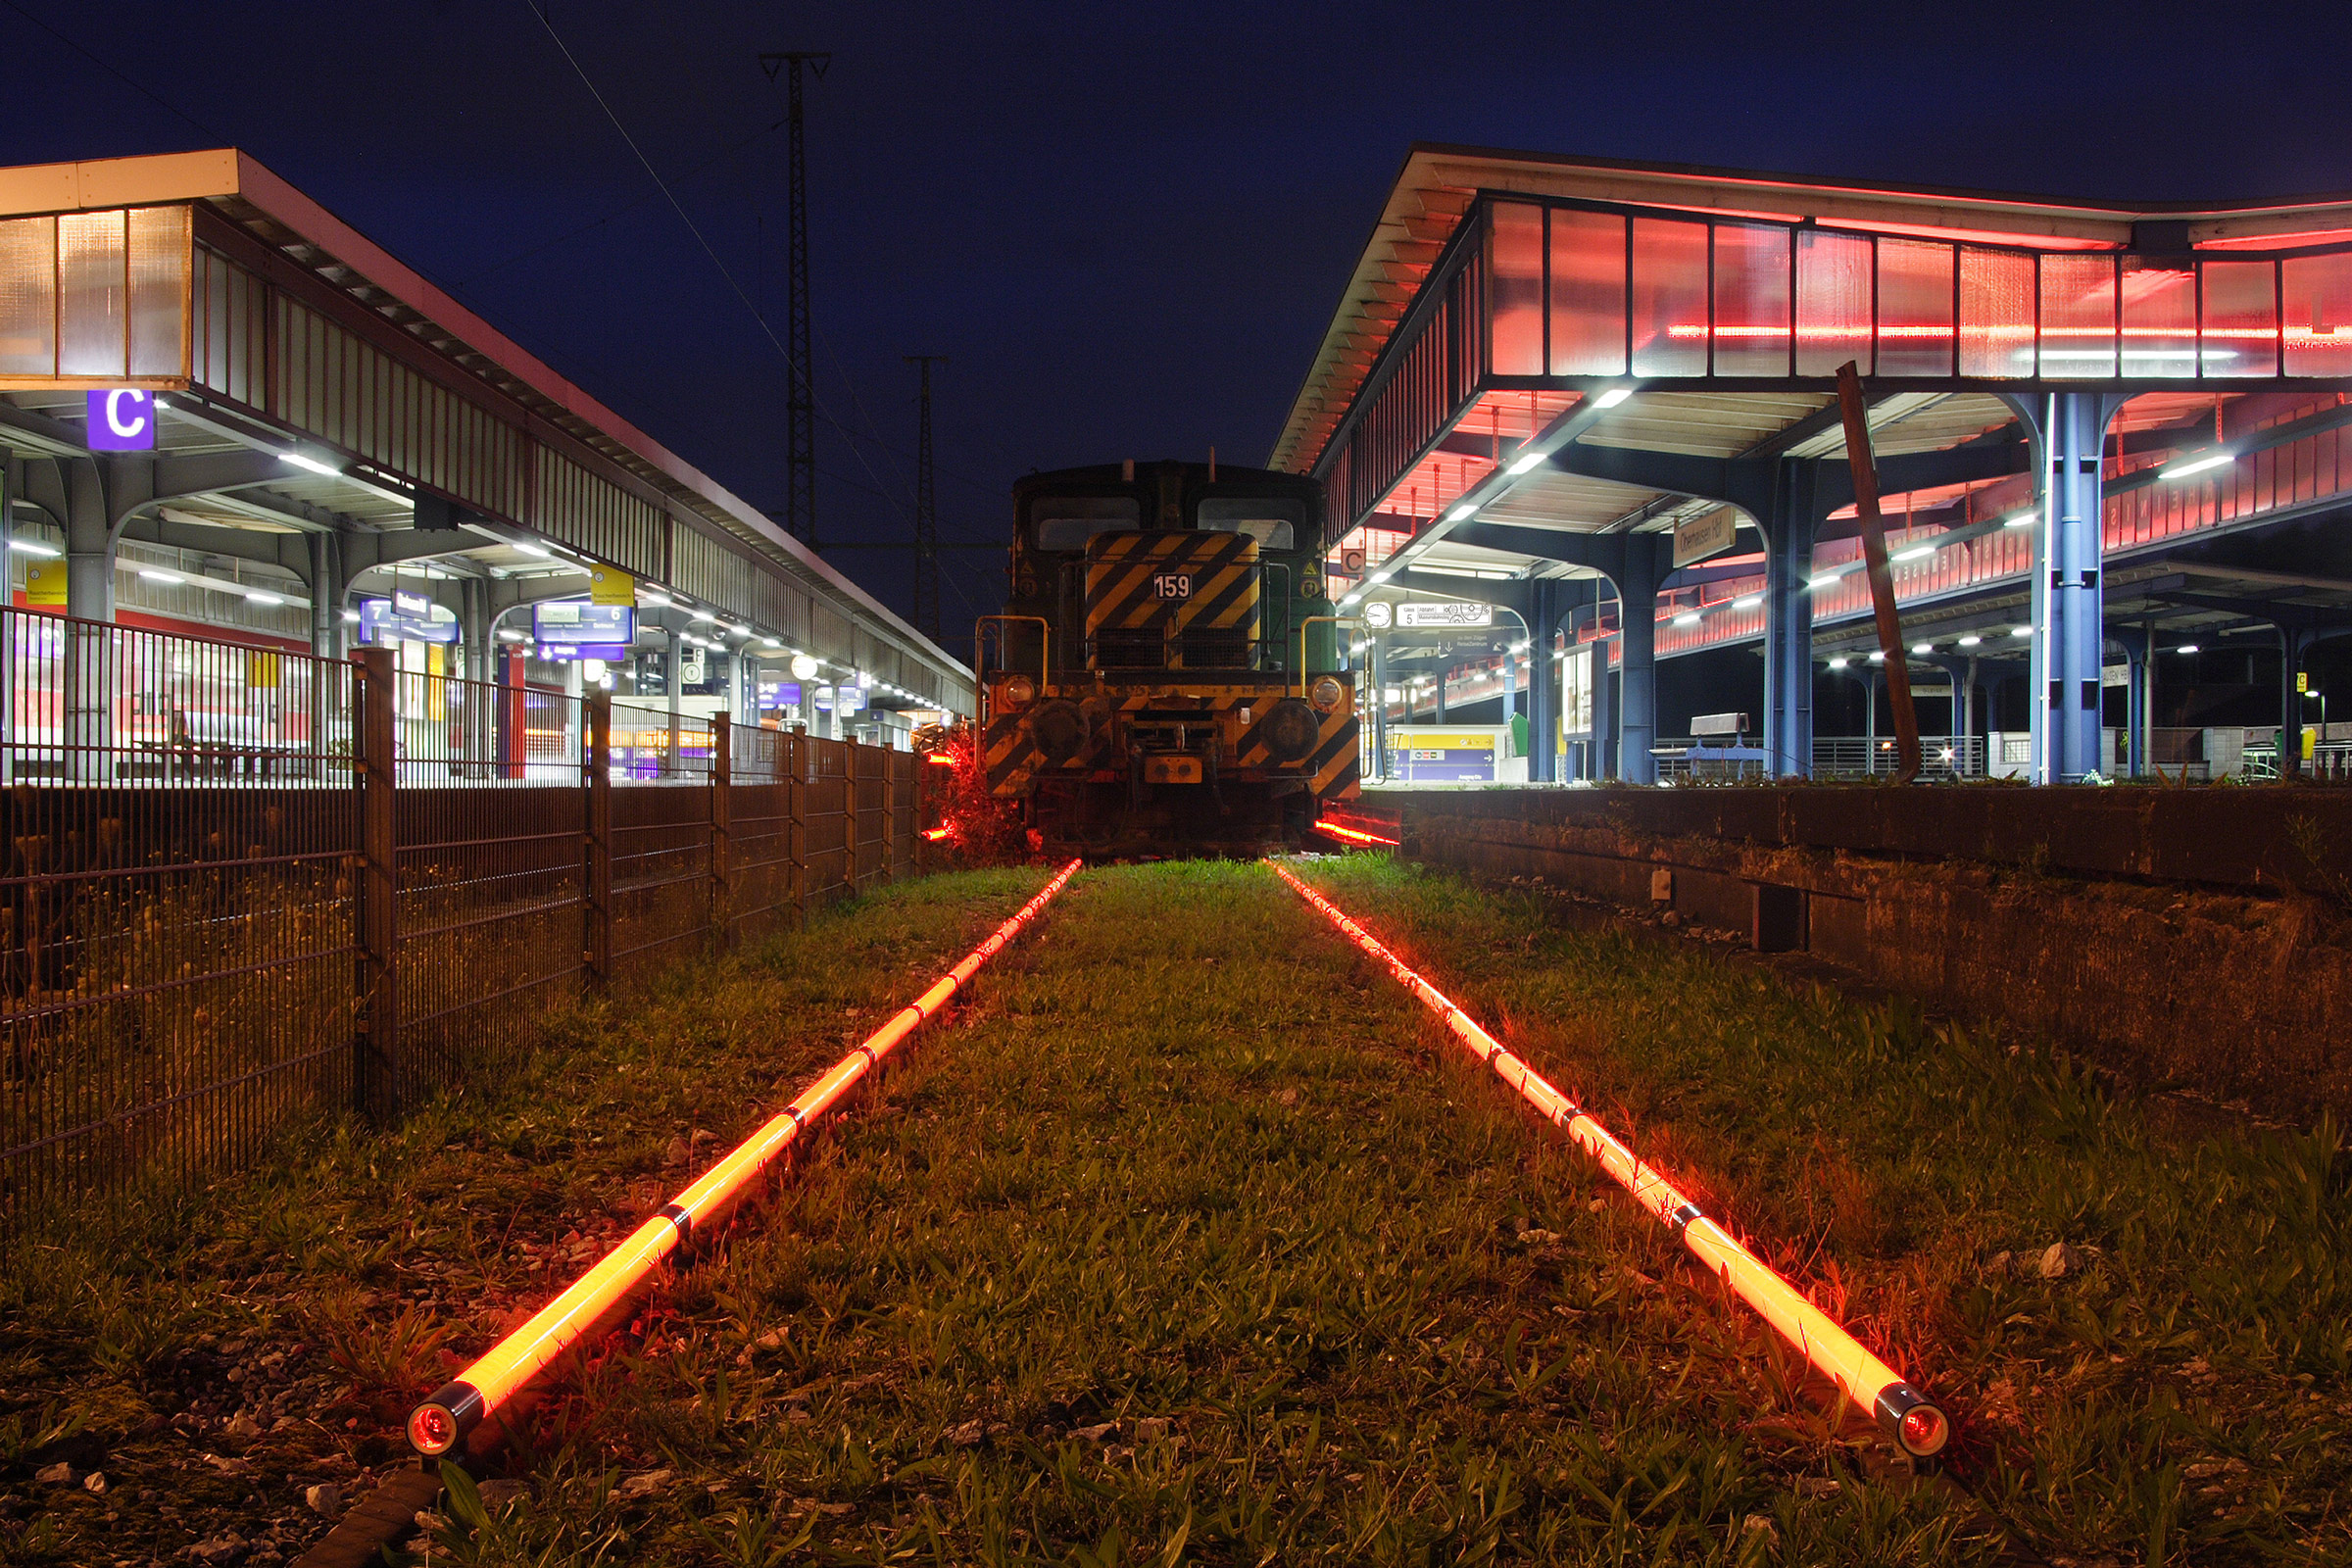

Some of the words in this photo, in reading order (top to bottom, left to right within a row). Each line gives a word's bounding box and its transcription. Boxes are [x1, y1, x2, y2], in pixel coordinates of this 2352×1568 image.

[106, 389, 145, 437] C
[1681, 526, 1710, 552] Oberhausen
[1712, 514, 1723, 540] Hbf
[1346, 552, 1362, 571] C
[1153, 575, 1190, 597] 159
[372, 607, 382, 619] 7
[611, 608, 620, 620] 6
[1406, 614, 1413, 624] 5
[696, 649, 703, 662] F
